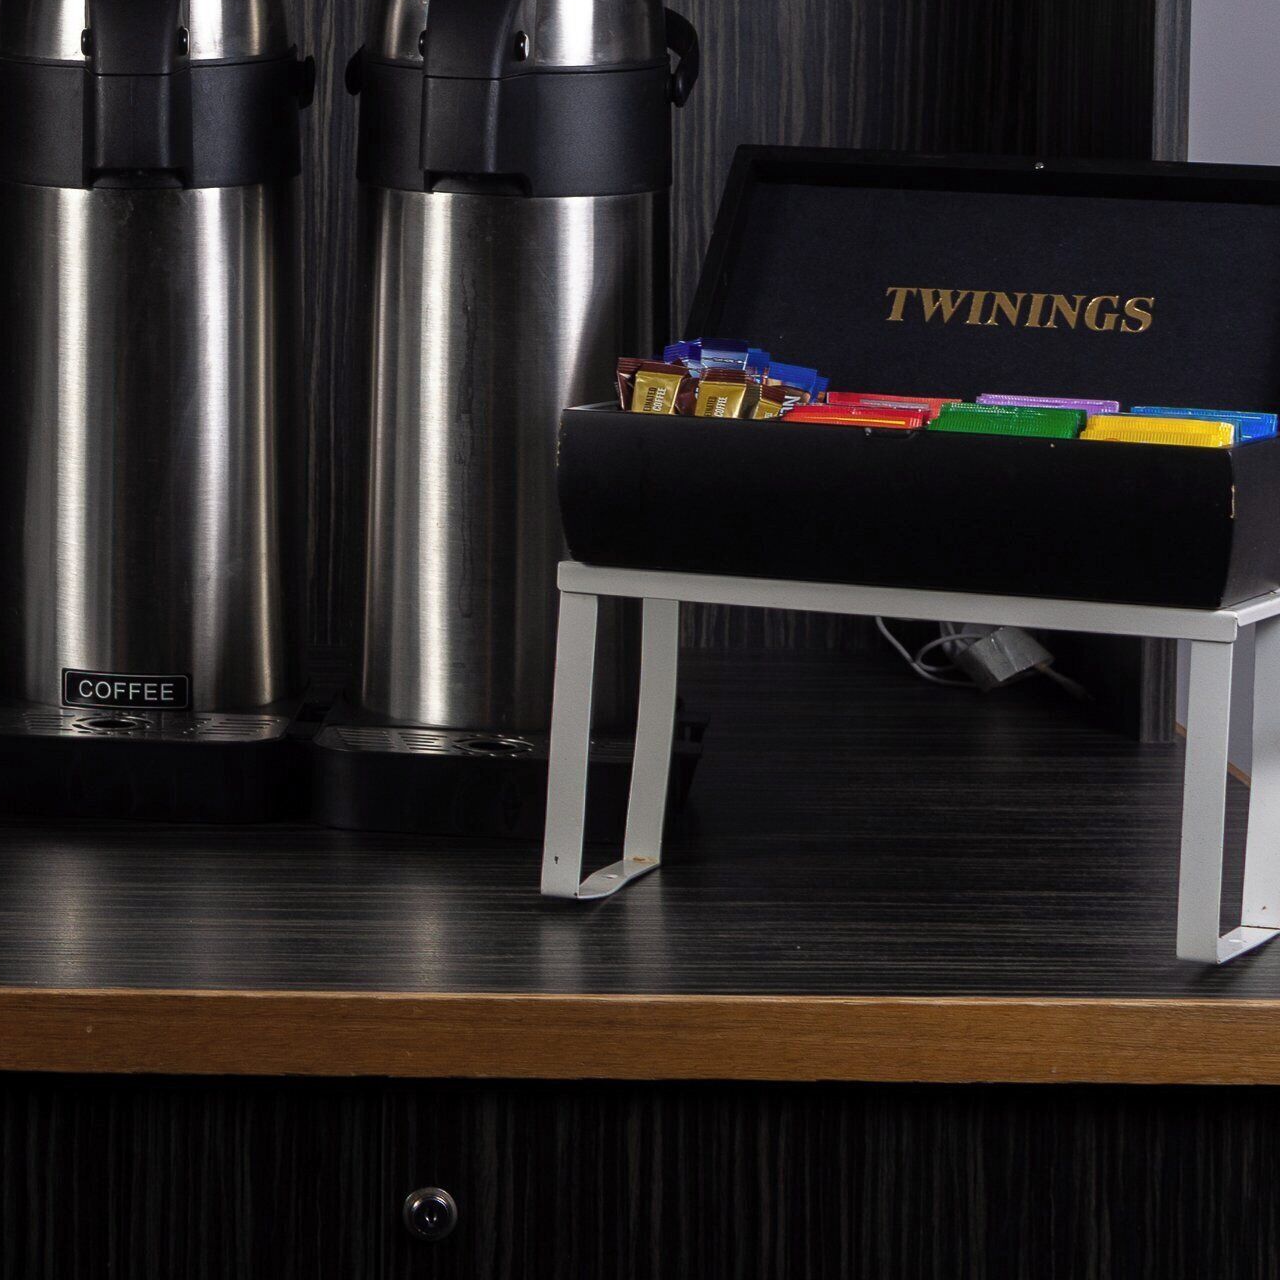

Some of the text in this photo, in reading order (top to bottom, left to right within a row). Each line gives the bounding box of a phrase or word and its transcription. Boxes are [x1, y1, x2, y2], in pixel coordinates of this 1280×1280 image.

[885, 286, 1156, 334] TWININGS
[652, 387, 667, 412] COFFEE
[714, 396, 728, 418] COFFEE
[78, 679, 175, 701] COFFEE
